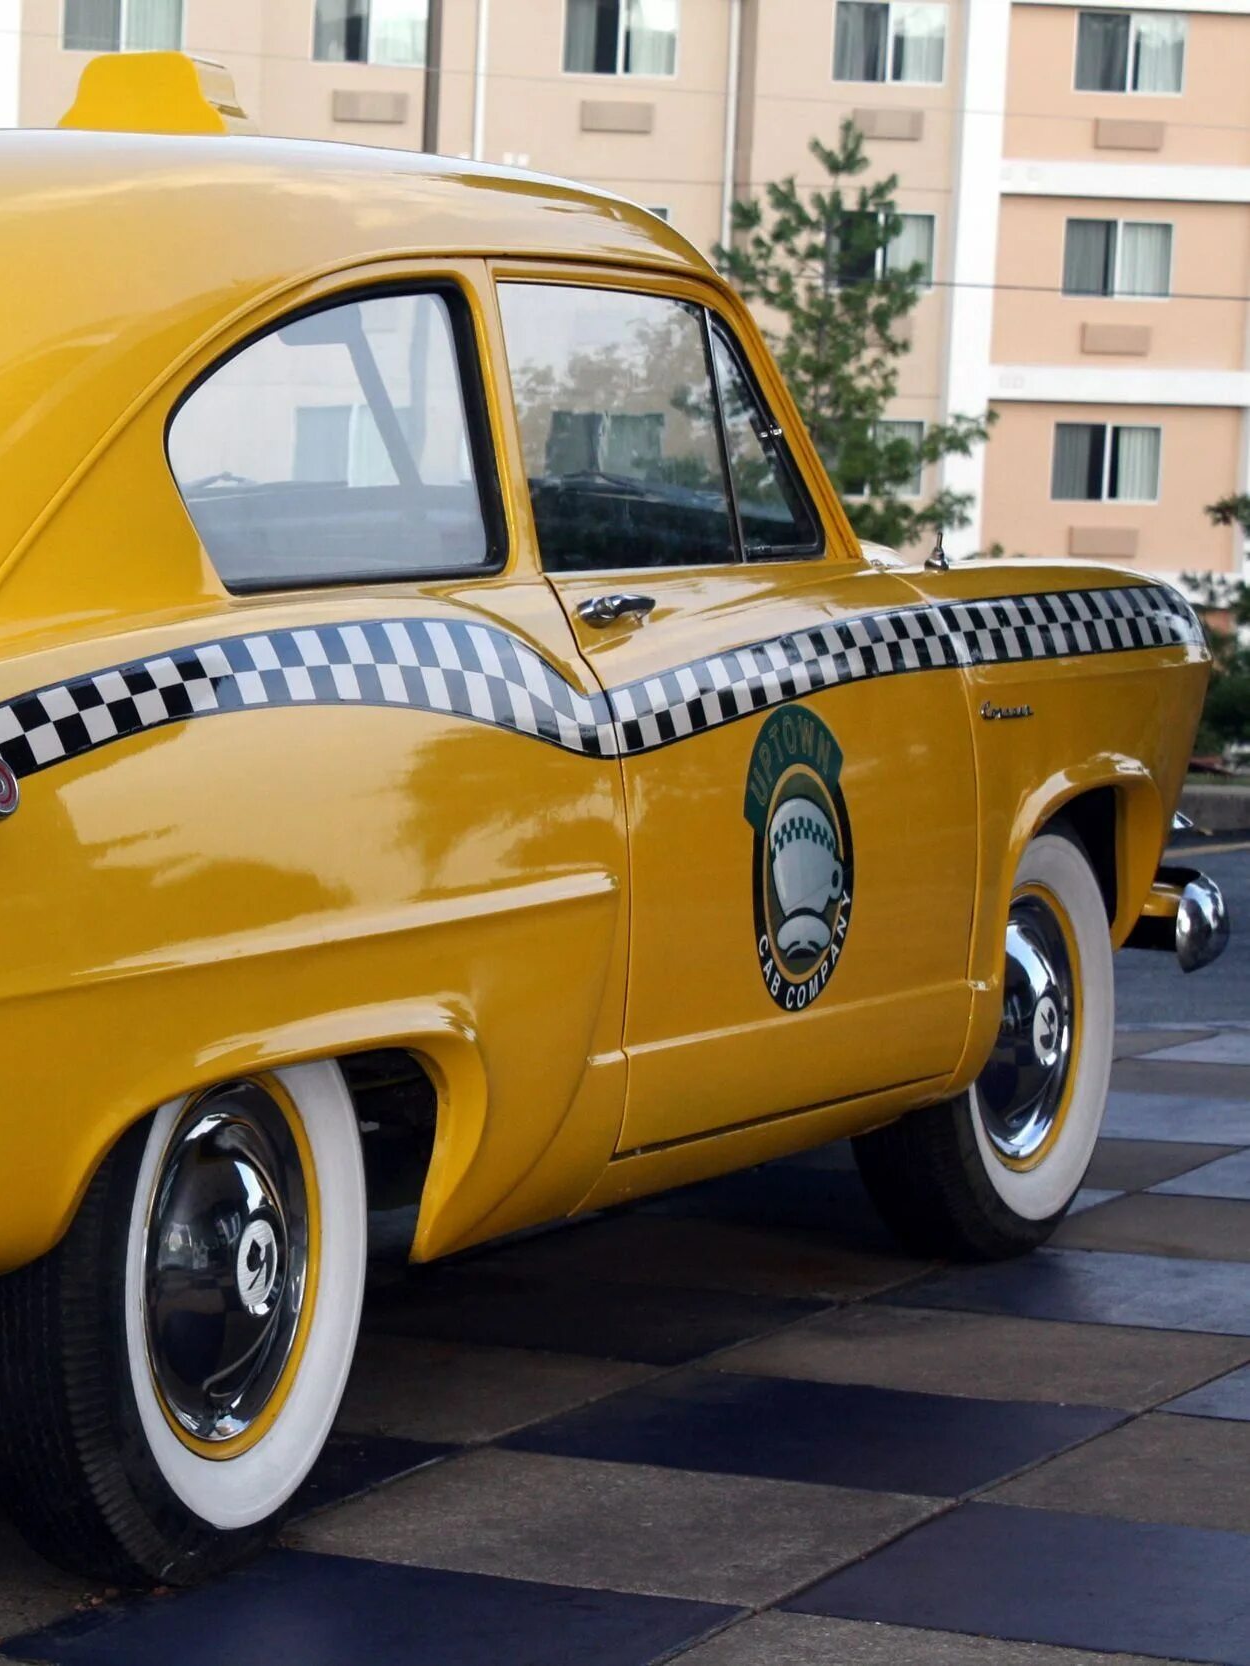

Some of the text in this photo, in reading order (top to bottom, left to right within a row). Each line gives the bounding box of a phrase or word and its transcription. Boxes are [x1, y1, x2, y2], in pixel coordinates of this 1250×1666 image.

[751, 714, 831, 807] UPTOWN
[757, 890, 851, 1010] CAB COMPANY
